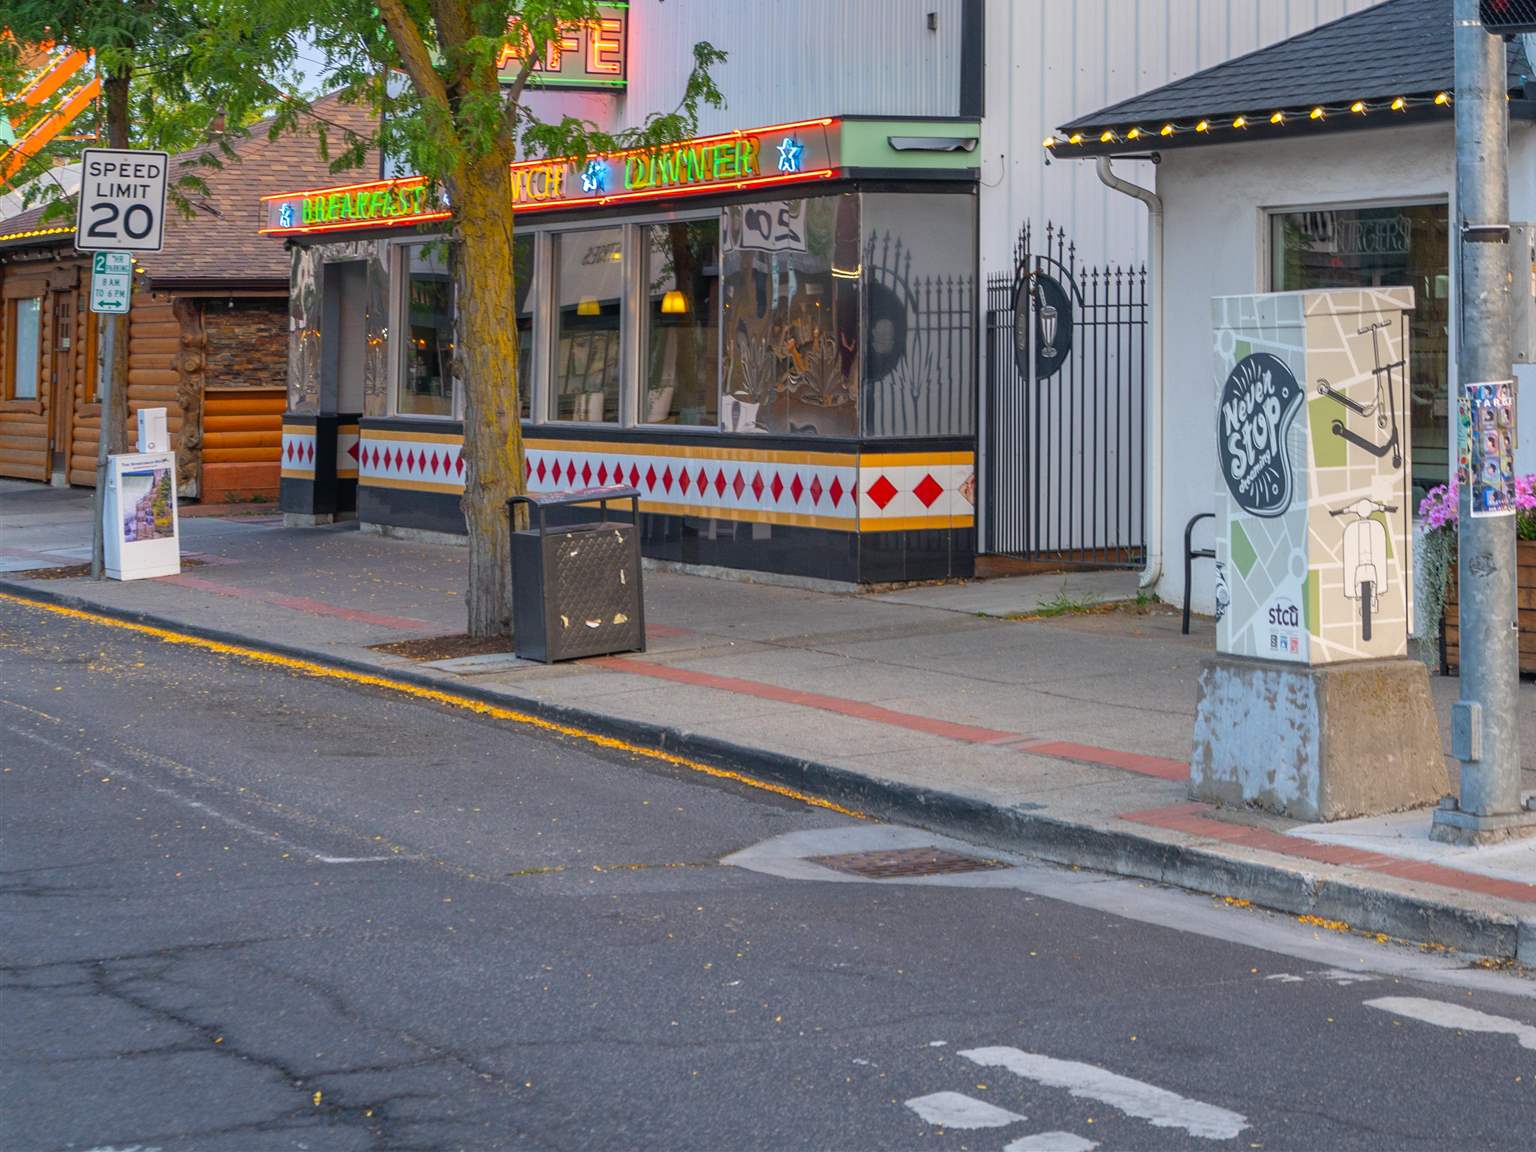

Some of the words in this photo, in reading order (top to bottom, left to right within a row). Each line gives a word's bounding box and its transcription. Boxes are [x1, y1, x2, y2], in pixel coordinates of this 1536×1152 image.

[496, 15, 622, 75] AFE
[89, 161, 161, 179] SPEED
[301, 185, 426, 226] BREAKFAST
[624, 136, 761, 191] DINNER
[96, 182, 151, 199] LIMIT
[87, 202, 154, 240] 20
[95, 255, 106, 272] 2
[96, 288, 104, 297] TO
[114, 289, 126, 298] PM
[109, 278, 120, 286] AM
[1222, 369, 1276, 437] Never
[1227, 395, 1281, 480] Stop
[1239, 449, 1271, 494] dreaming
[1269, 603, 1299, 627] stcu
